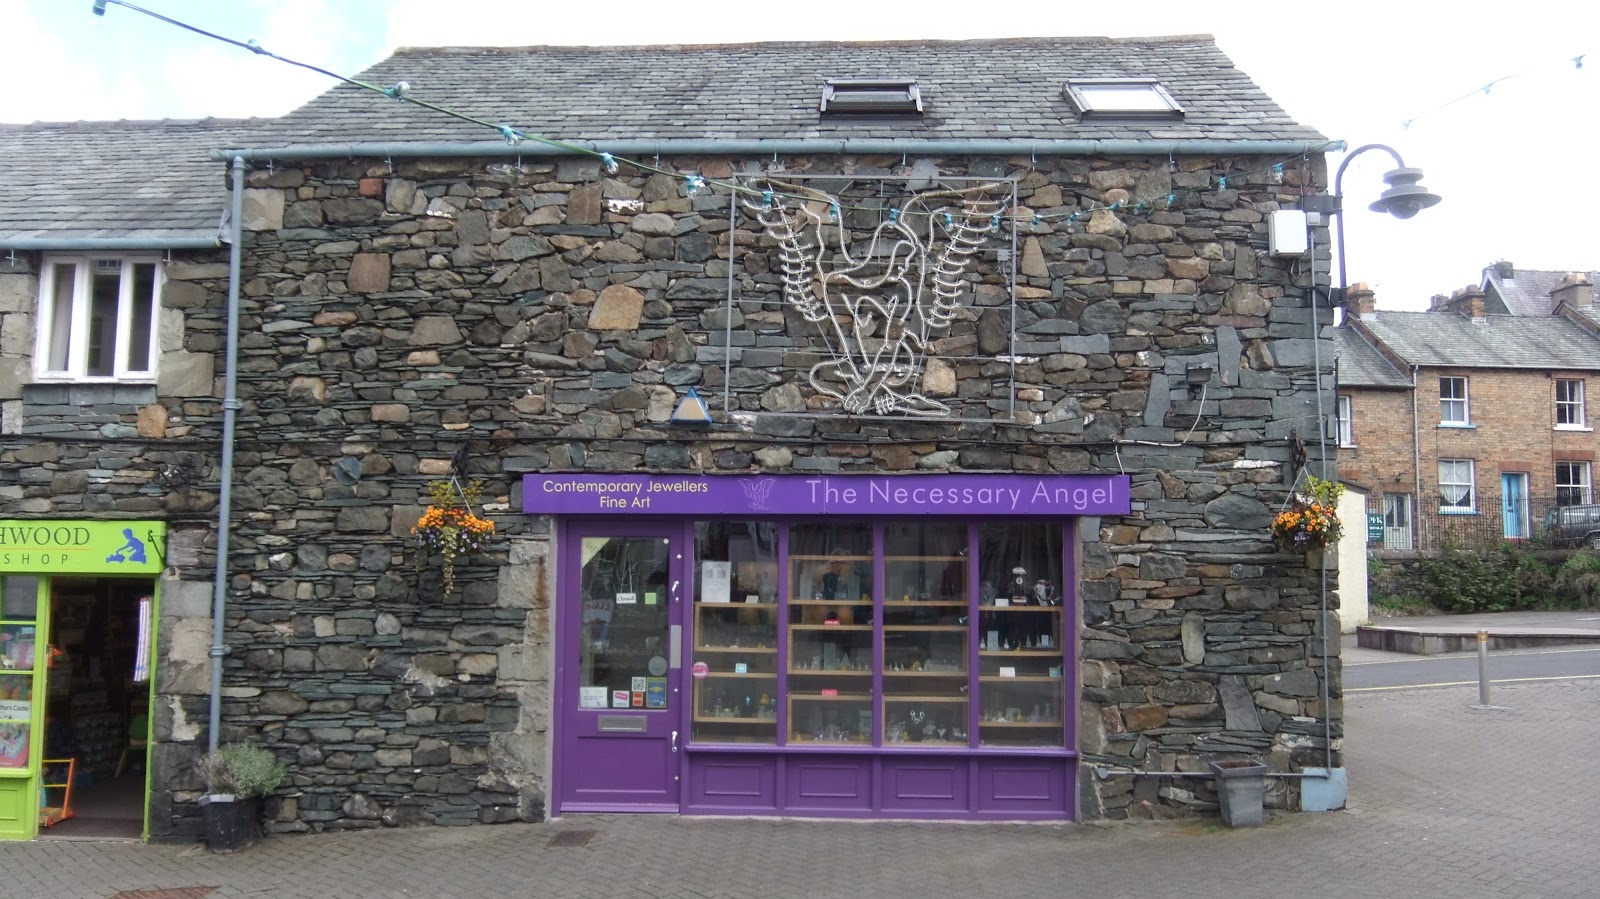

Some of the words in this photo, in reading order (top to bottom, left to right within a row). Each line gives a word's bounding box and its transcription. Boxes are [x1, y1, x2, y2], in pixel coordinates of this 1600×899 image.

[543, 480, 642, 494] Contemporary
[646, 480, 708, 492] Jewellers
[806, 480, 857, 504] The
[869, 480, 1021, 510] Necessary
[1031, 480, 1114, 510] Angel
[600, 496, 627, 508] Fine
[631, 496, 651, 508] Art
[4, 553, 68, 565] SHOP
